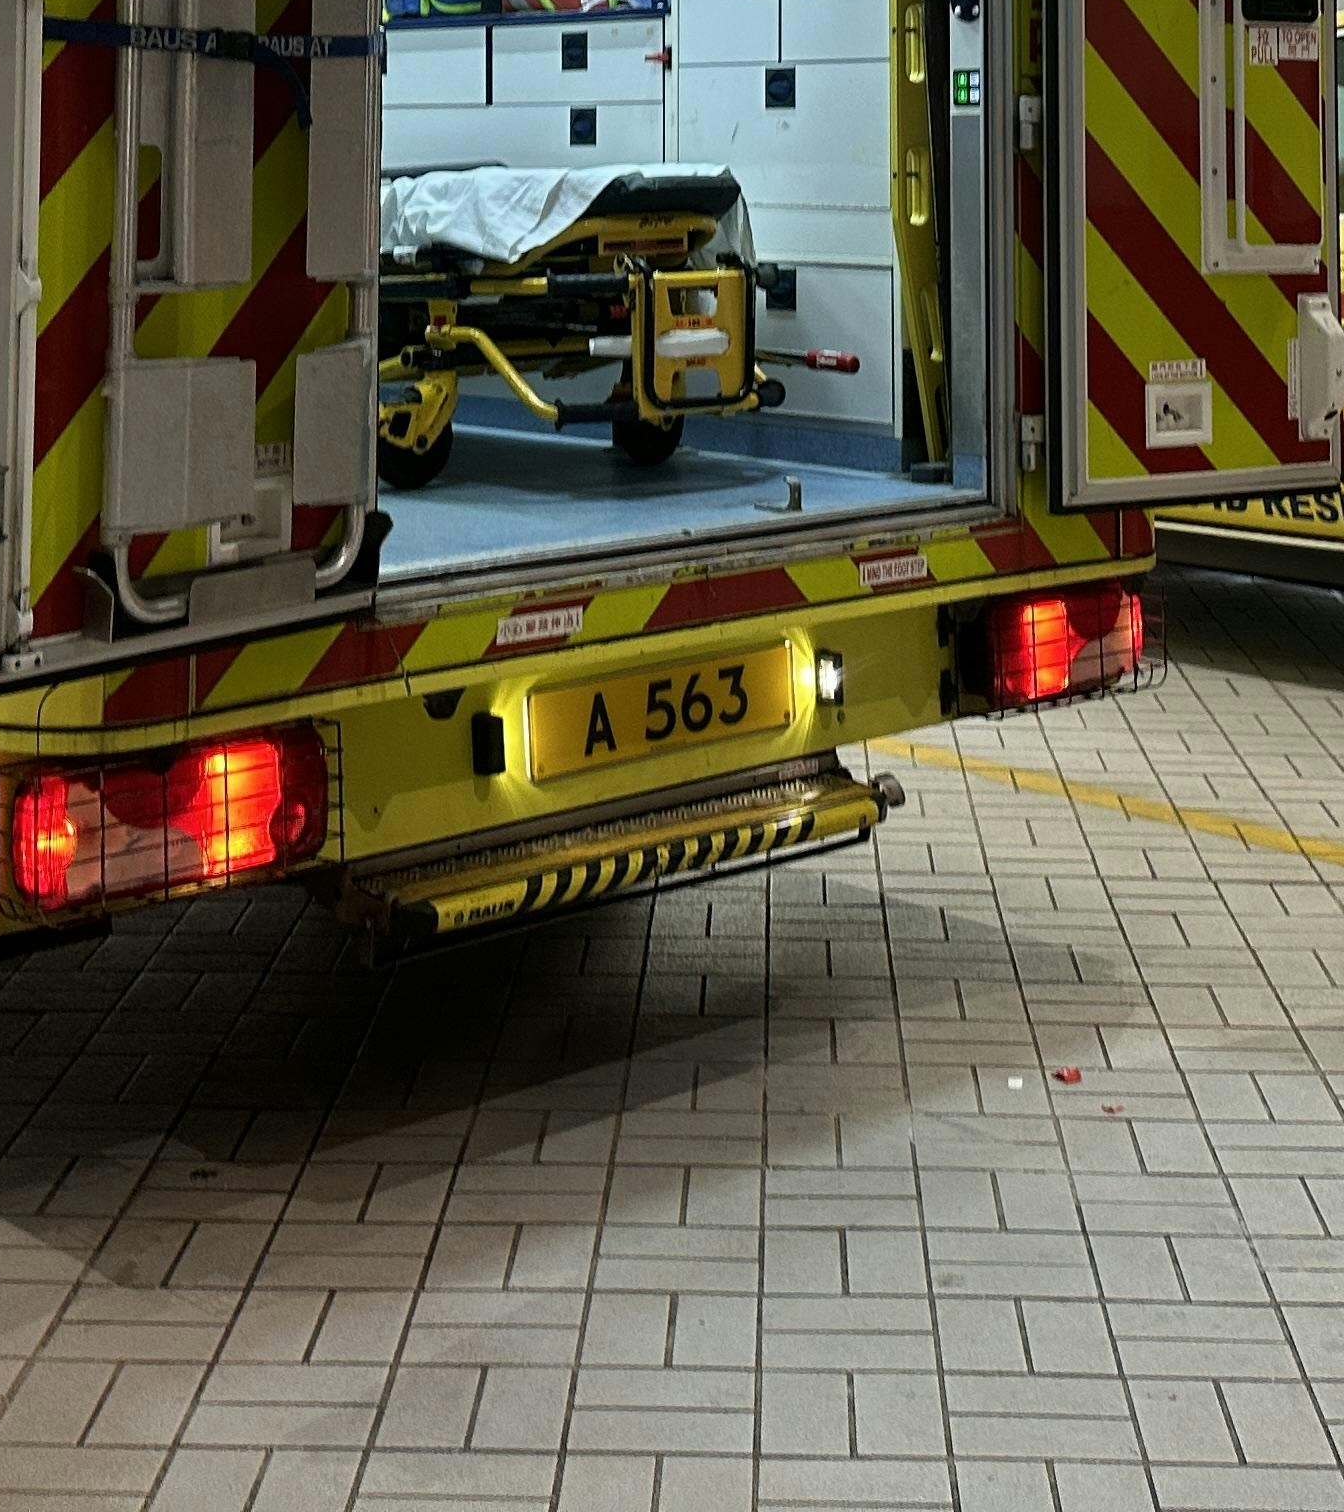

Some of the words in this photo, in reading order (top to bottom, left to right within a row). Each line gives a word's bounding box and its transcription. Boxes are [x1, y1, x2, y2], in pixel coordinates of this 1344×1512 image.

[1295, 29, 1318, 48] OPEN
[1251, 45, 1276, 65] PULL
[584, 691, 618, 757] A
[645, 664, 749, 742] 563
